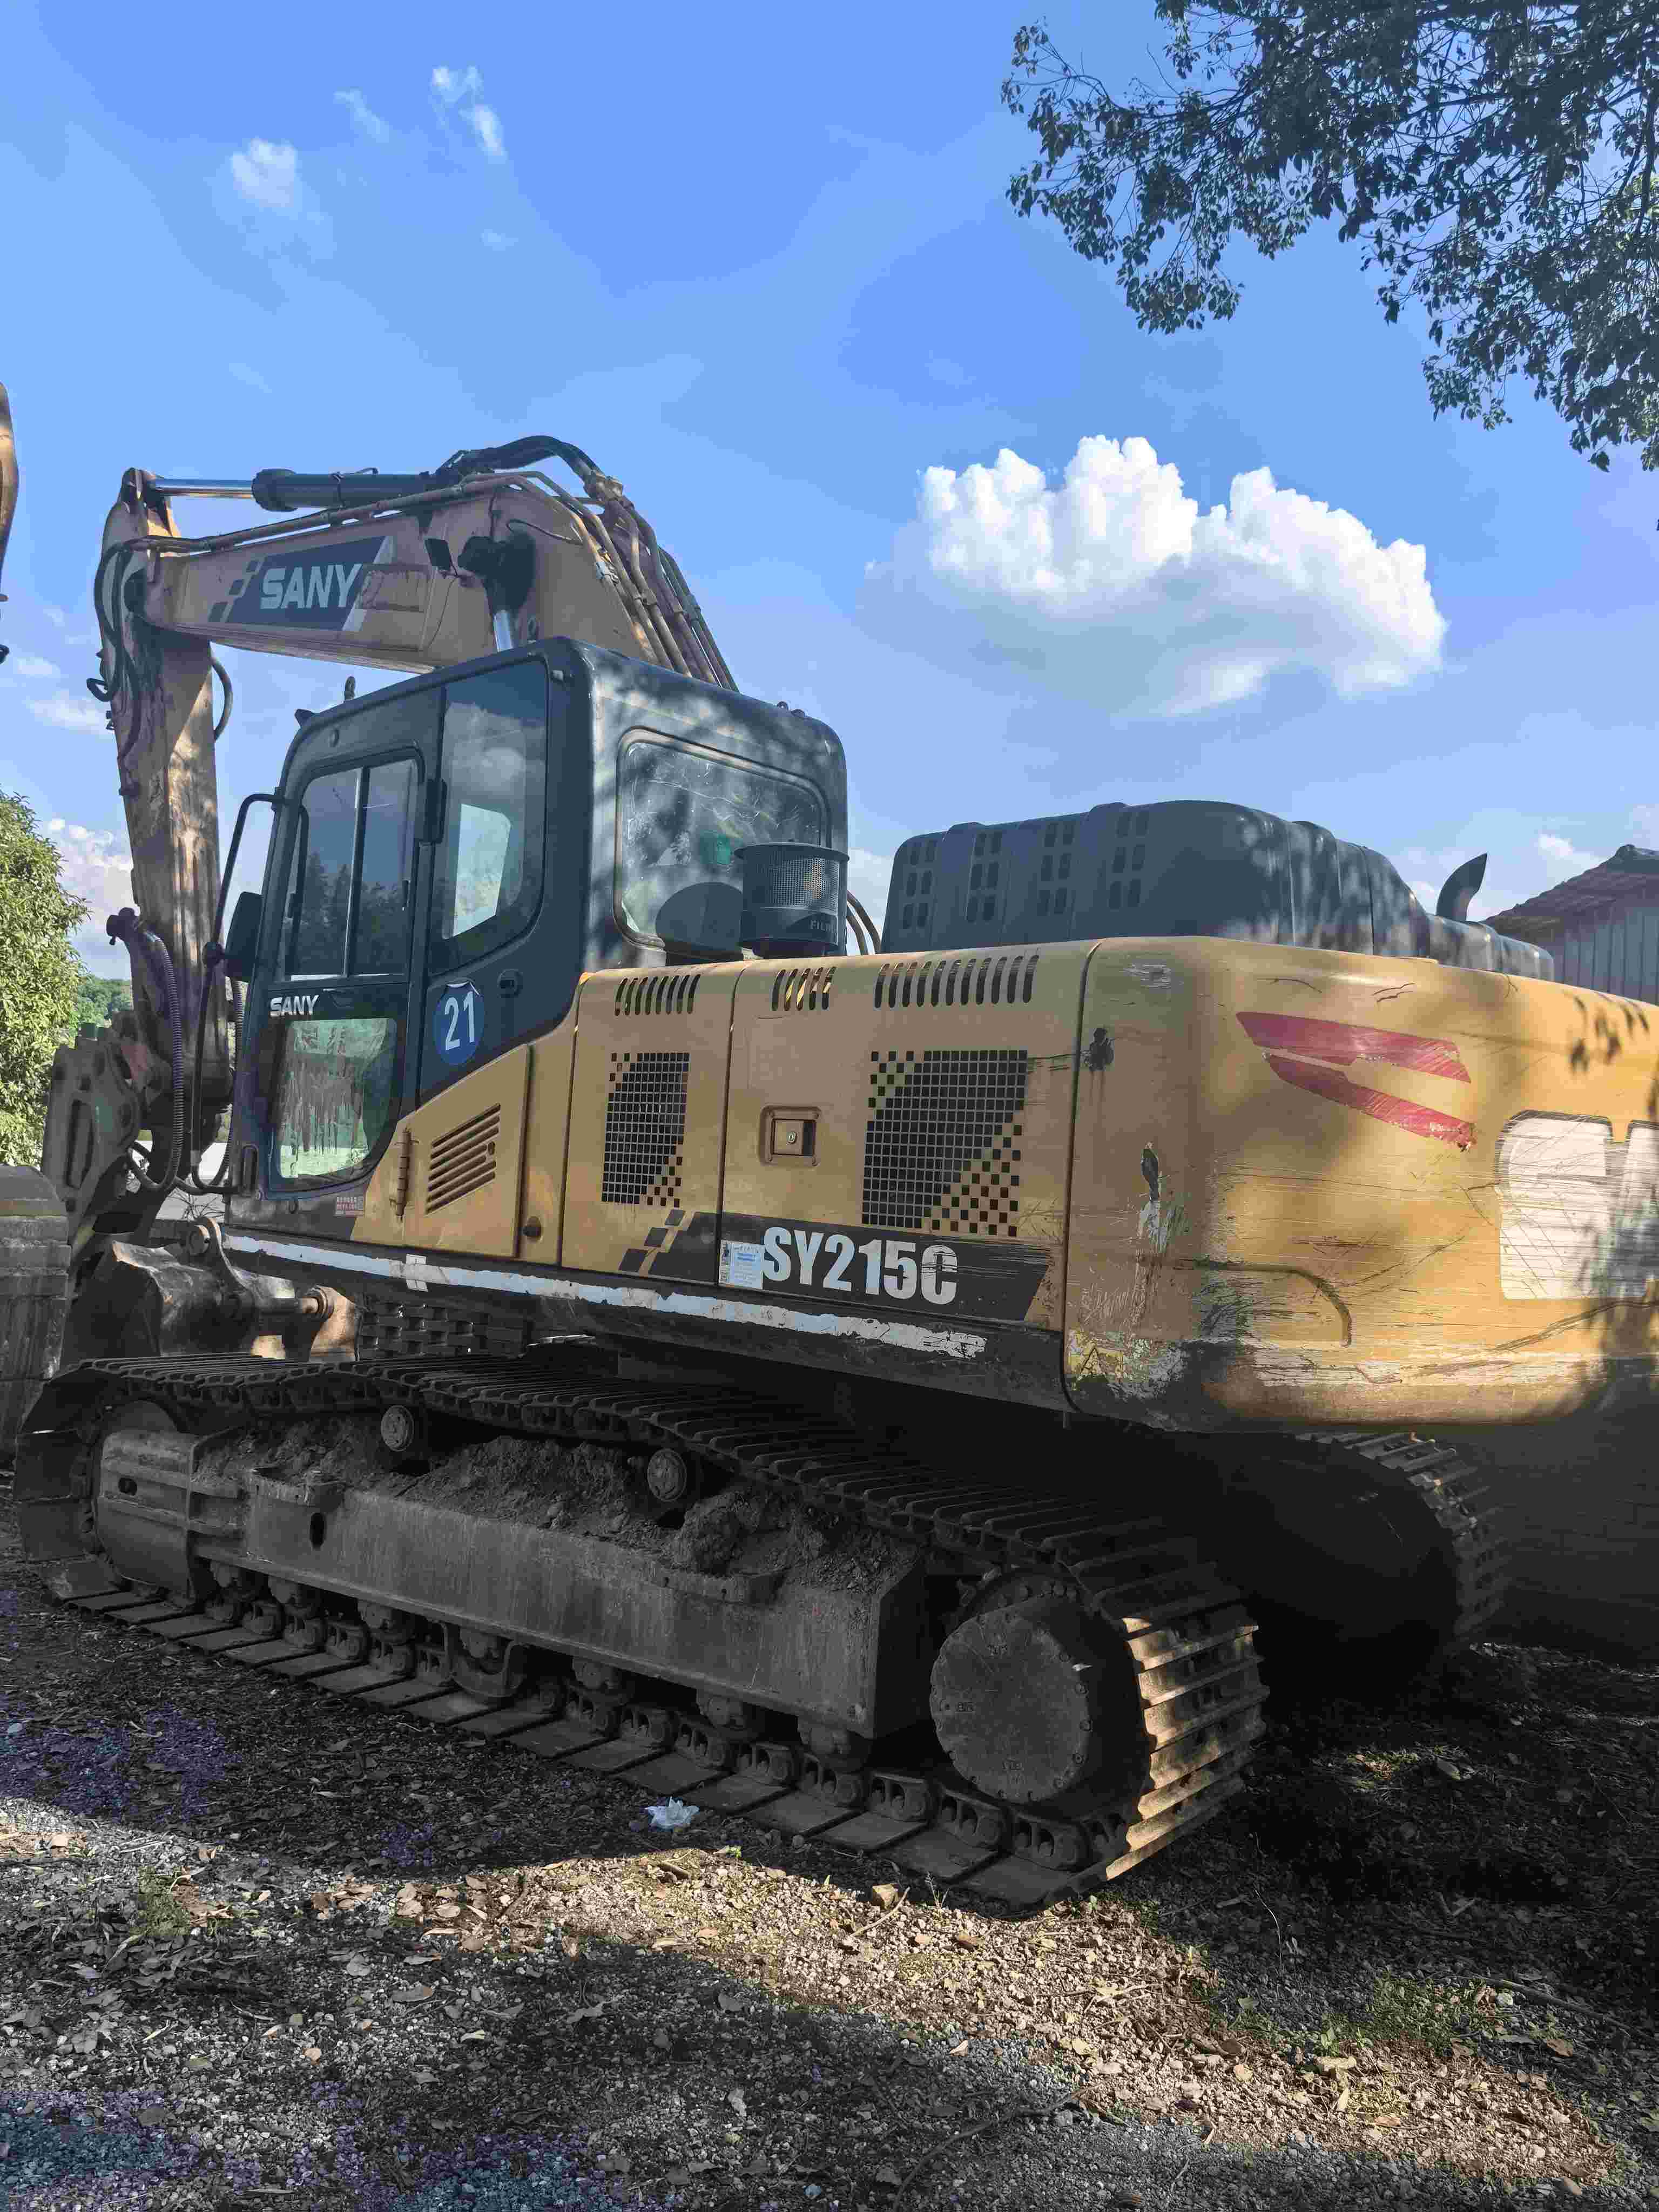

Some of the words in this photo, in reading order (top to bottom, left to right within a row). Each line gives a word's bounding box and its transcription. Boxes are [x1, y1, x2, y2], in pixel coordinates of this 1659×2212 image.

[260, 564, 362, 609] SANY
[270, 995, 319, 1017] SANY
[444, 992, 475, 1051] 21
[764, 1226, 958, 1305] SY215C
